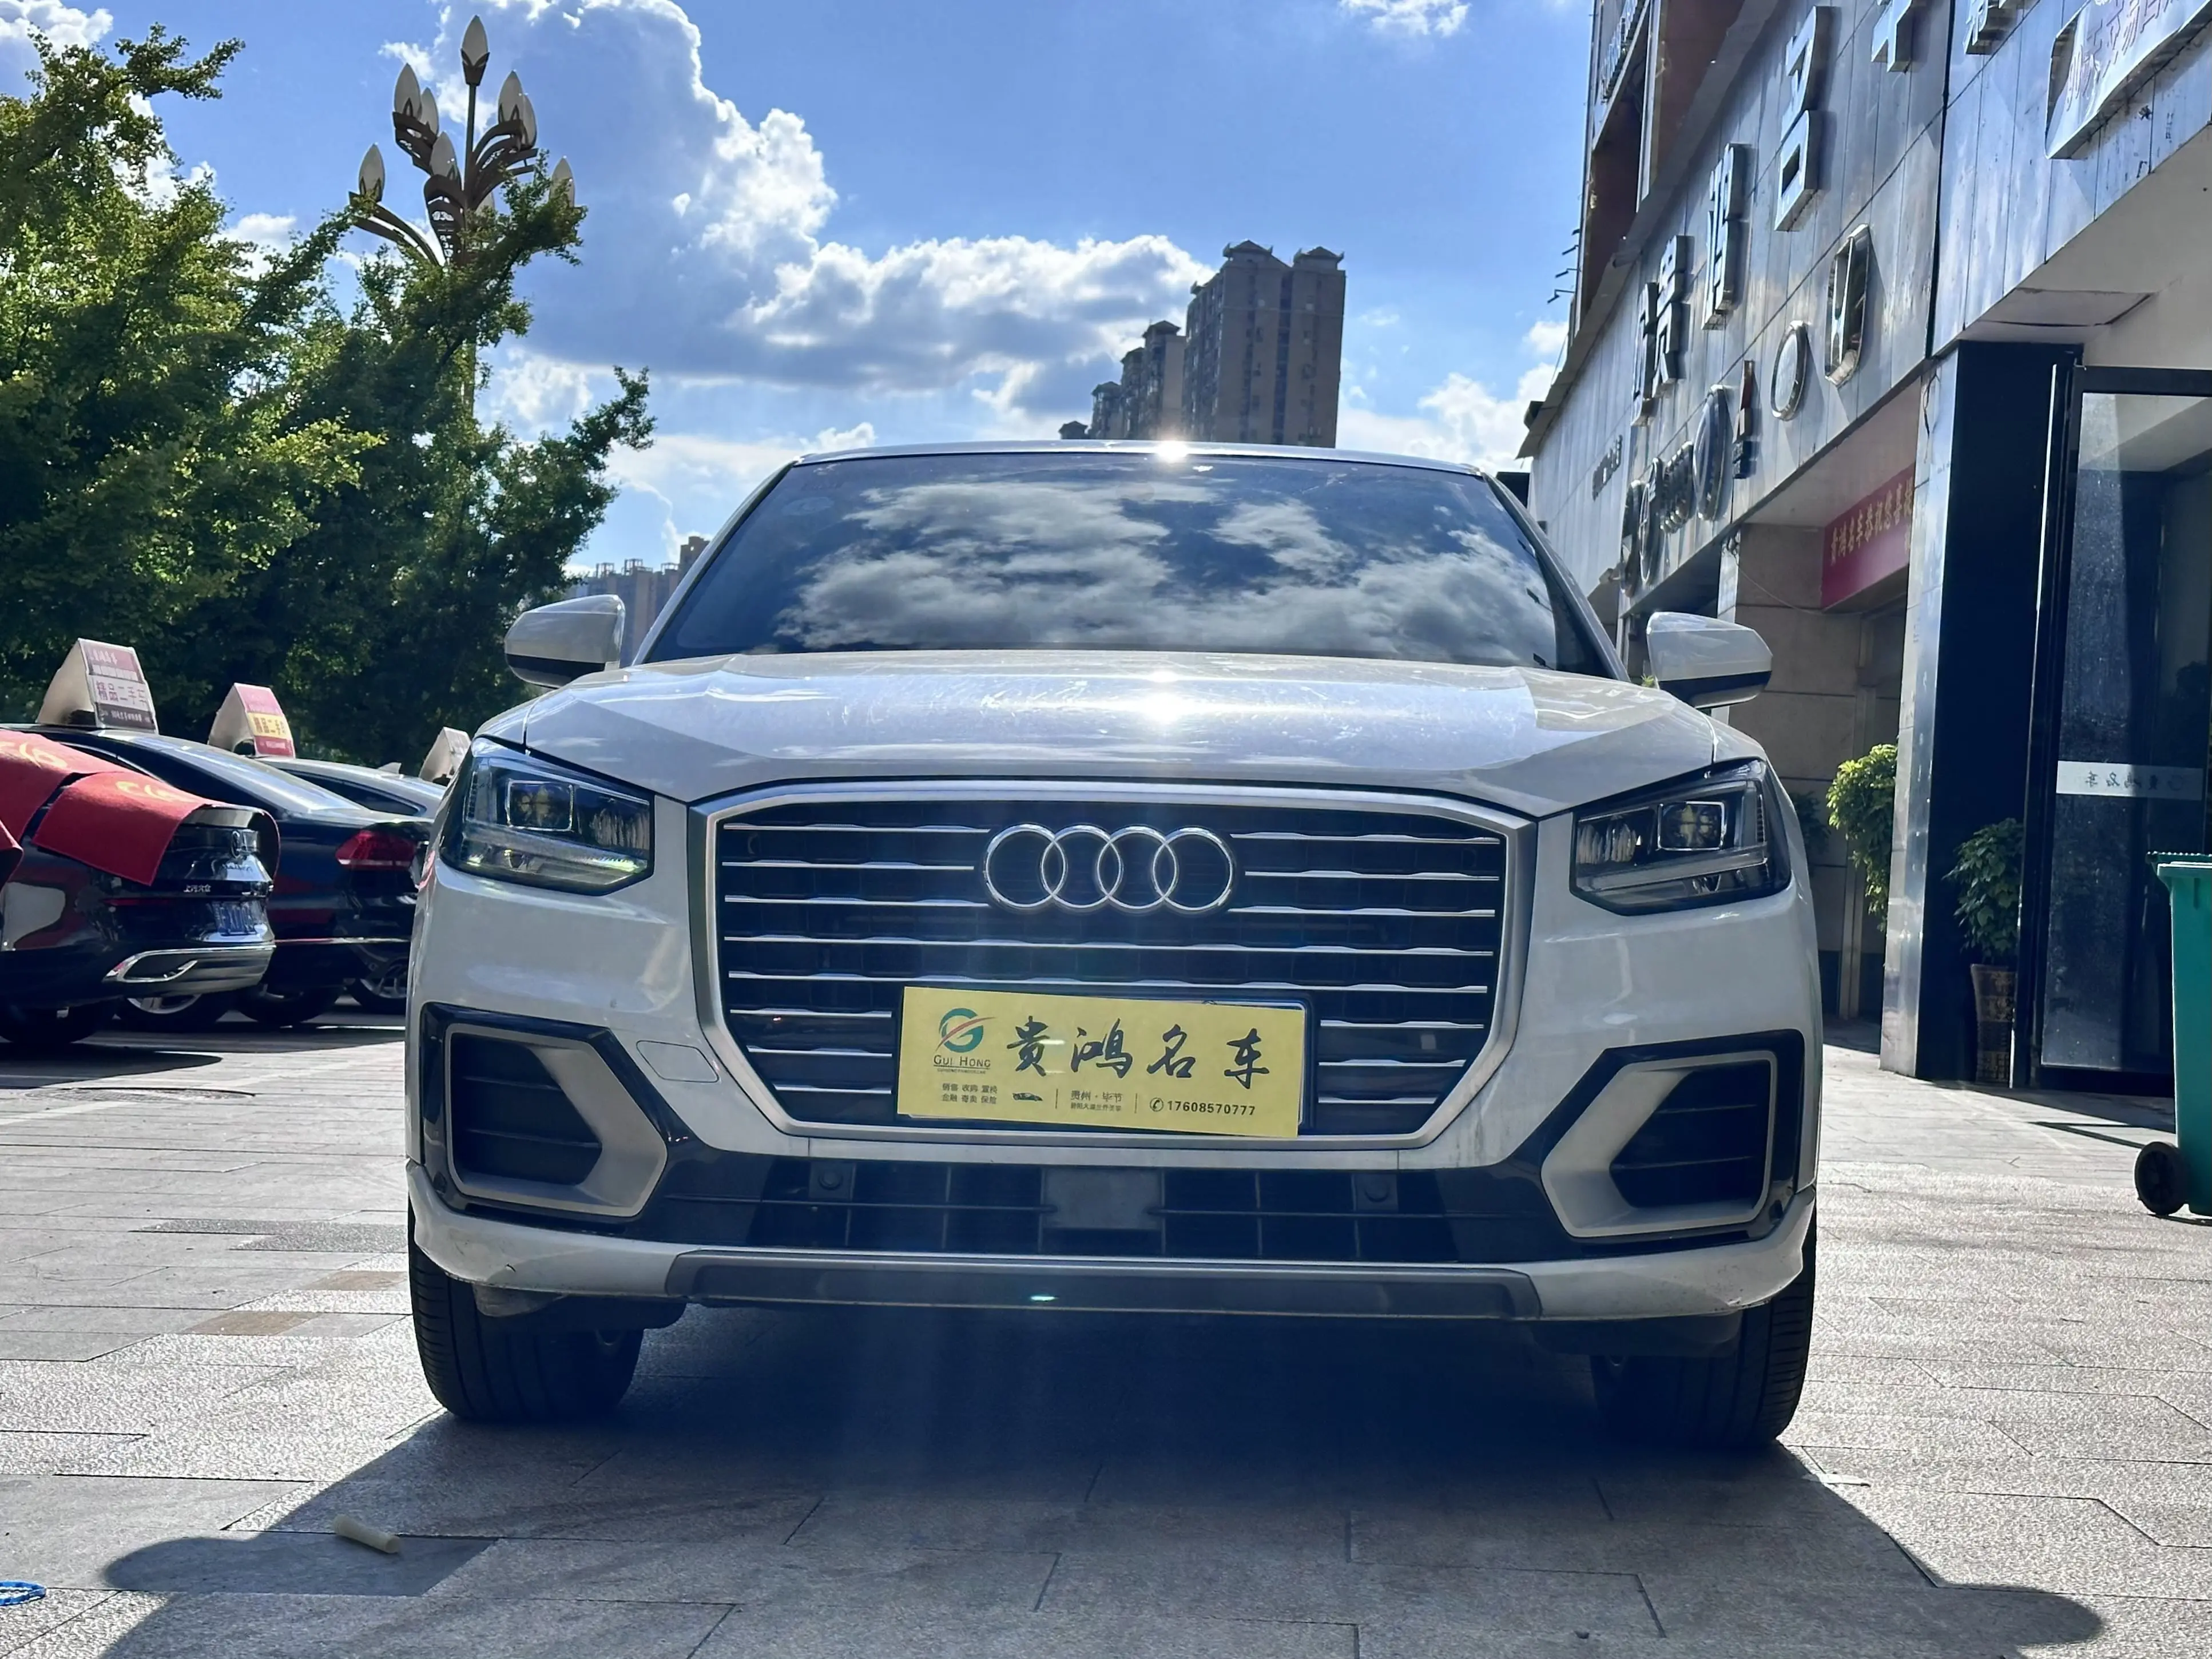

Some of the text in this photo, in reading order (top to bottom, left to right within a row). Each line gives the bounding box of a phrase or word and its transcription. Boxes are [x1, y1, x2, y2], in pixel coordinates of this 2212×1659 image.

[1006, 1016, 1269, 1089] 贵鸿名车
[1167, 1100, 1255, 1116] 17608570777
